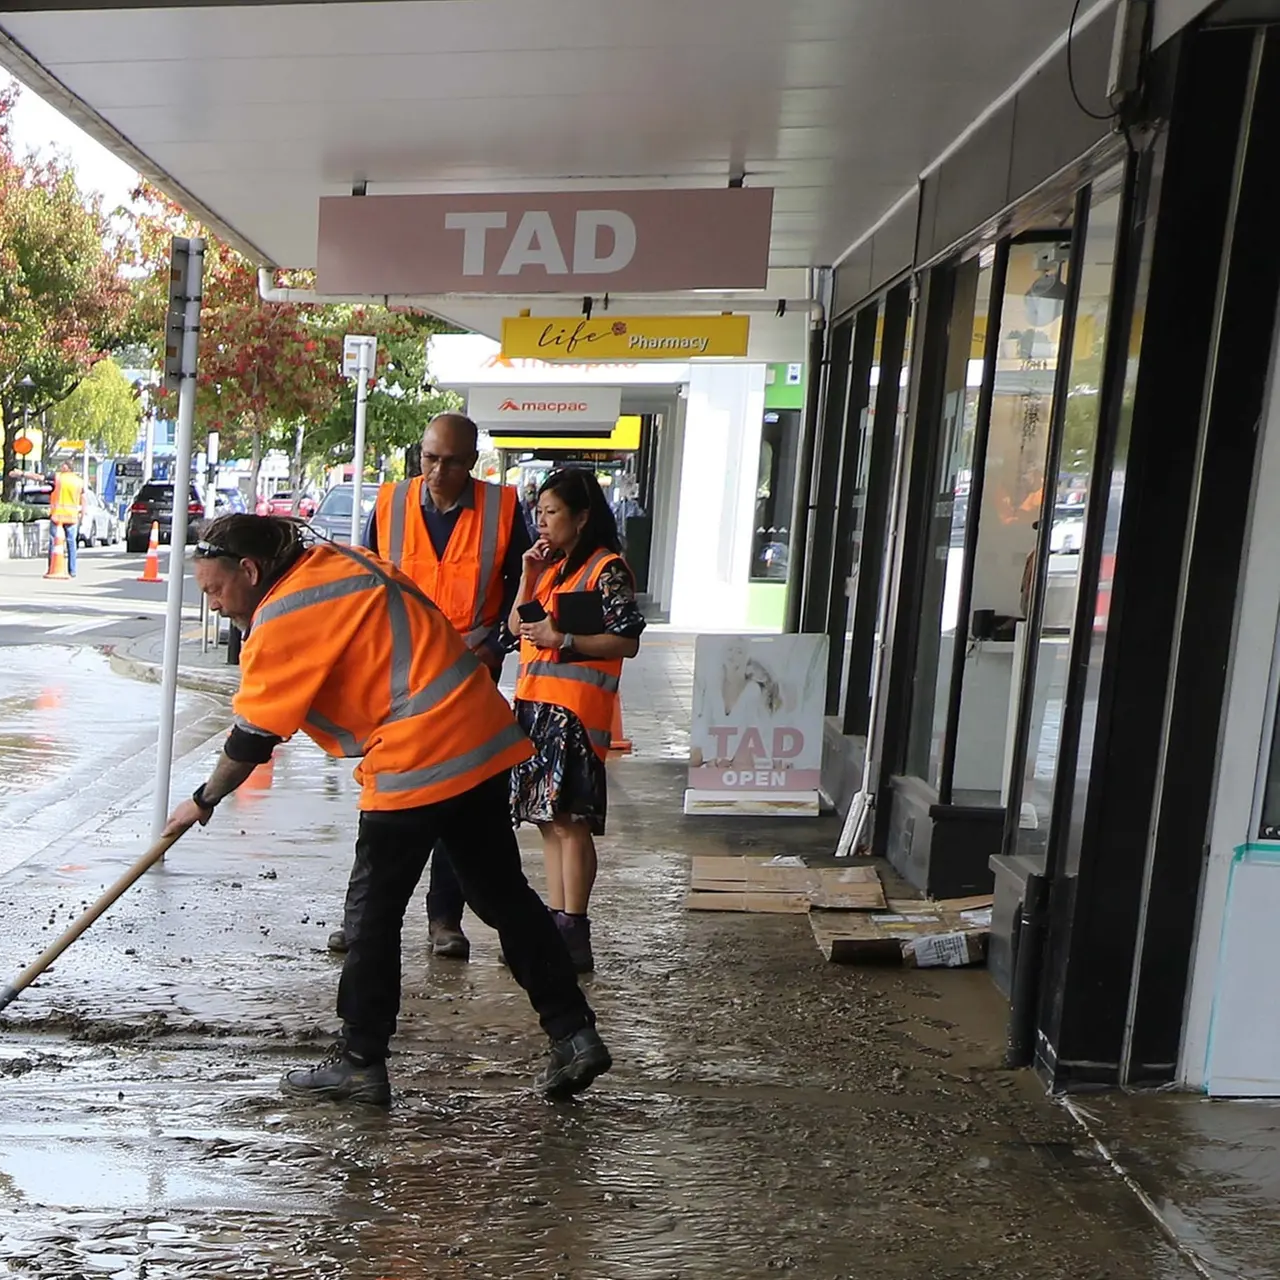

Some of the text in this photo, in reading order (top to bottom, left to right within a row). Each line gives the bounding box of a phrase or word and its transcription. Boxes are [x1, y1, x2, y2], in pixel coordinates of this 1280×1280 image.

[444, 209, 637, 276] TAD
[538, 320, 606, 353] life
[628, 334, 709, 351] Pharmacy
[521, 400, 588, 413] macpac
[708, 726, 805, 760] TAD
[722, 770, 786, 786] OPEN
